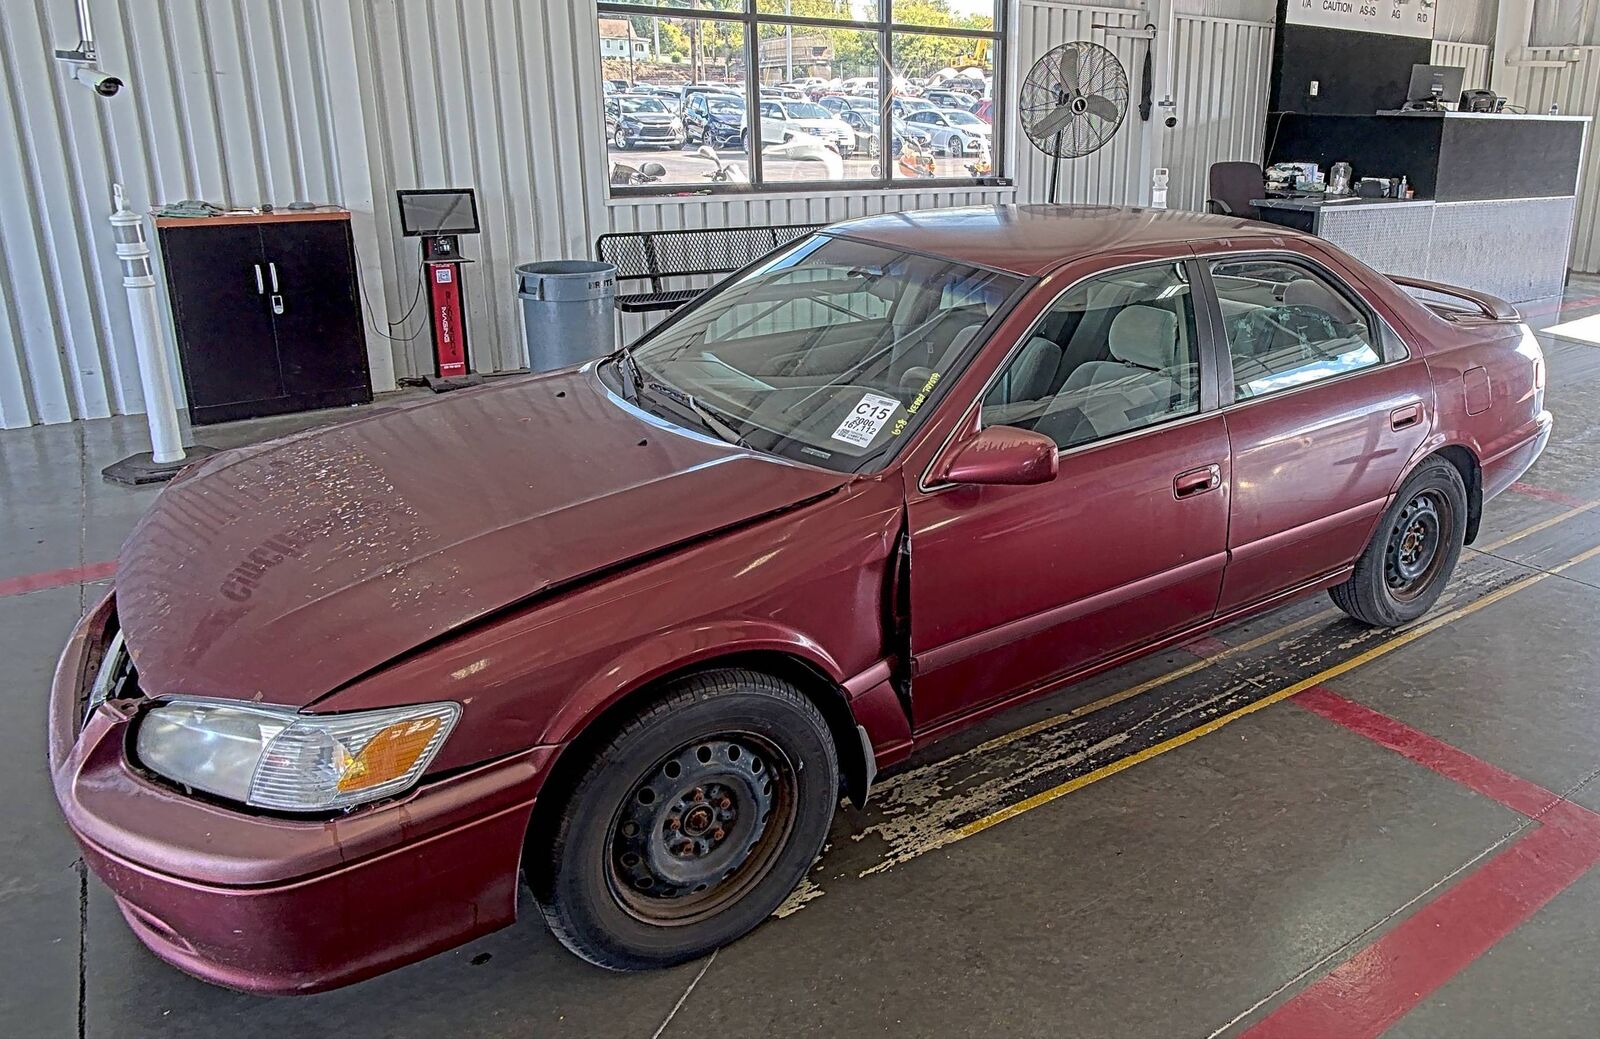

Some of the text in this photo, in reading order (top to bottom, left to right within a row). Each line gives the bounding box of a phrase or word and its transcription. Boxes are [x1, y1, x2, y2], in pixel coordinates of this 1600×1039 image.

[1322, 0, 1353, 13] CAUTION
[1360, 5, 1376, 16] AS-IS
[1391, 9, 1401, 19] AG
[441, 306, 450, 343] IMAGING
[856, 403, 891, 420] C15
[854, 416, 875, 427] 2000
[891, 418, 908, 436] 658
